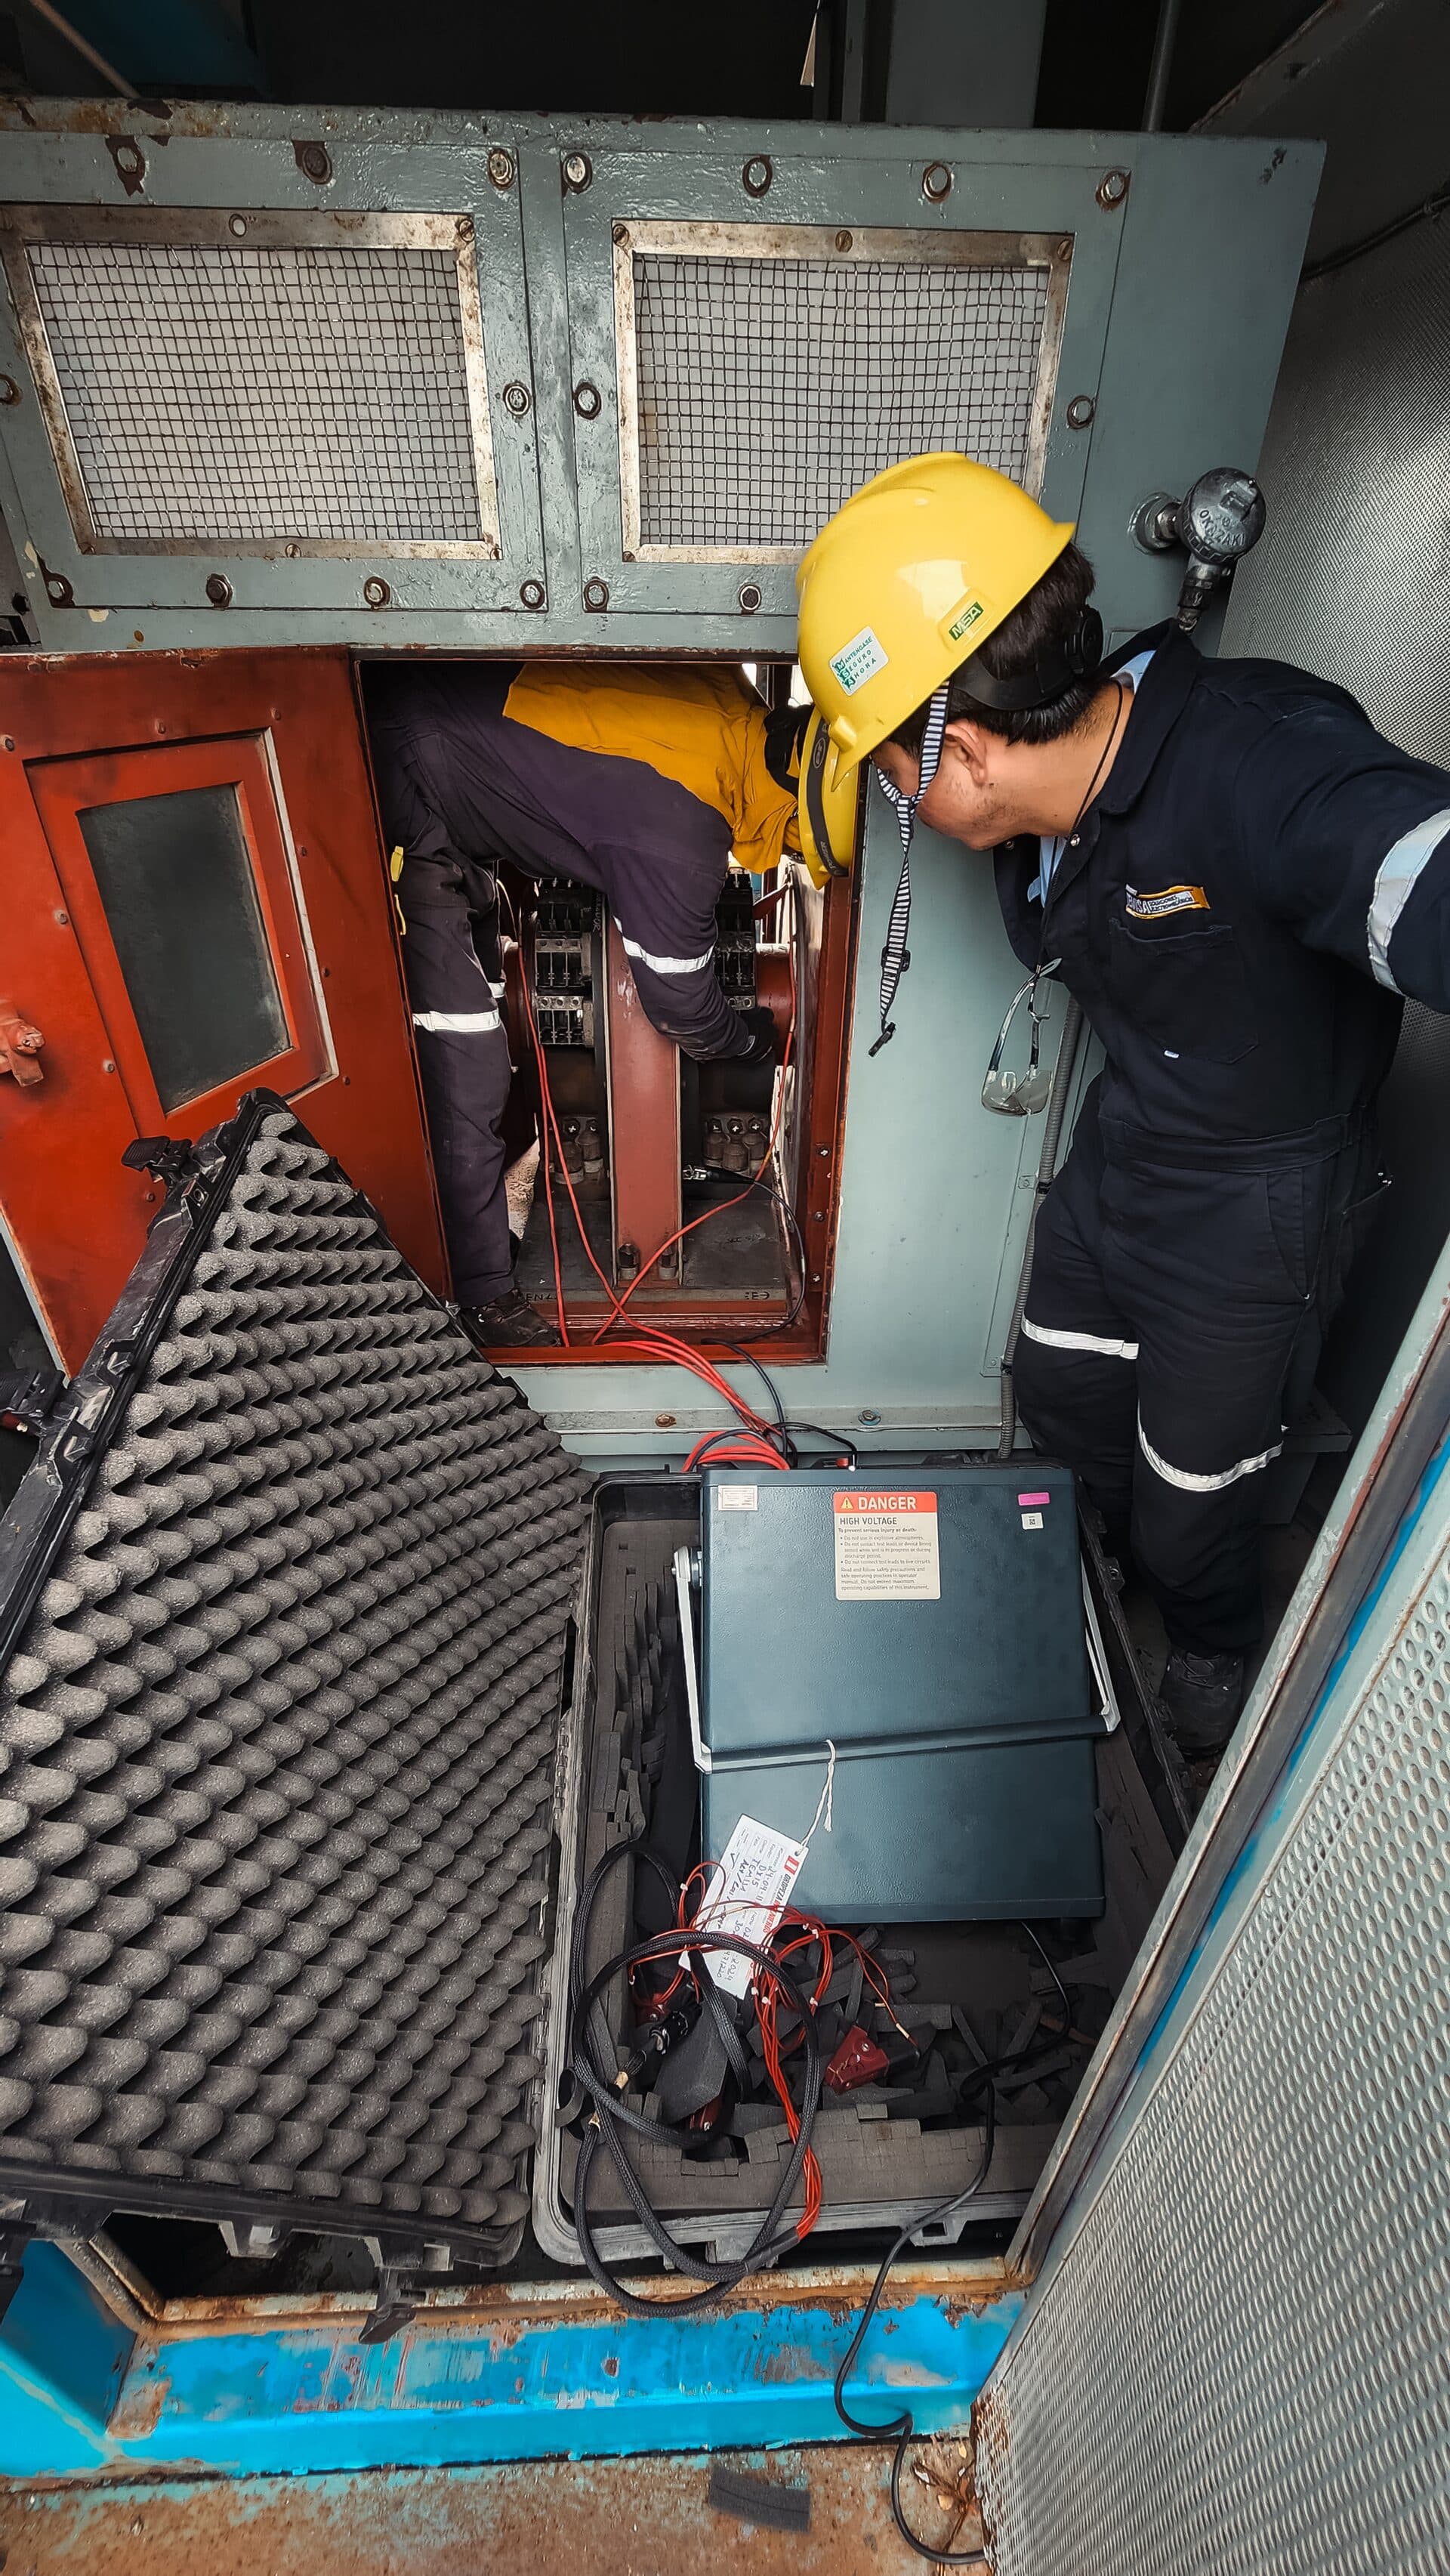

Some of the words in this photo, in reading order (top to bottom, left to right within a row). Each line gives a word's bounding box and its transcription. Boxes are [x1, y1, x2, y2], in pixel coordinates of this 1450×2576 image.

[952, 606, 982, 638] MSA
[857, 1496, 916, 1510] DANGER
[840, 1517, 859, 1525] HIGH
[862, 1517, 897, 1525] VOLTAGE
[774, 1873, 791, 1901] OROPEZA
